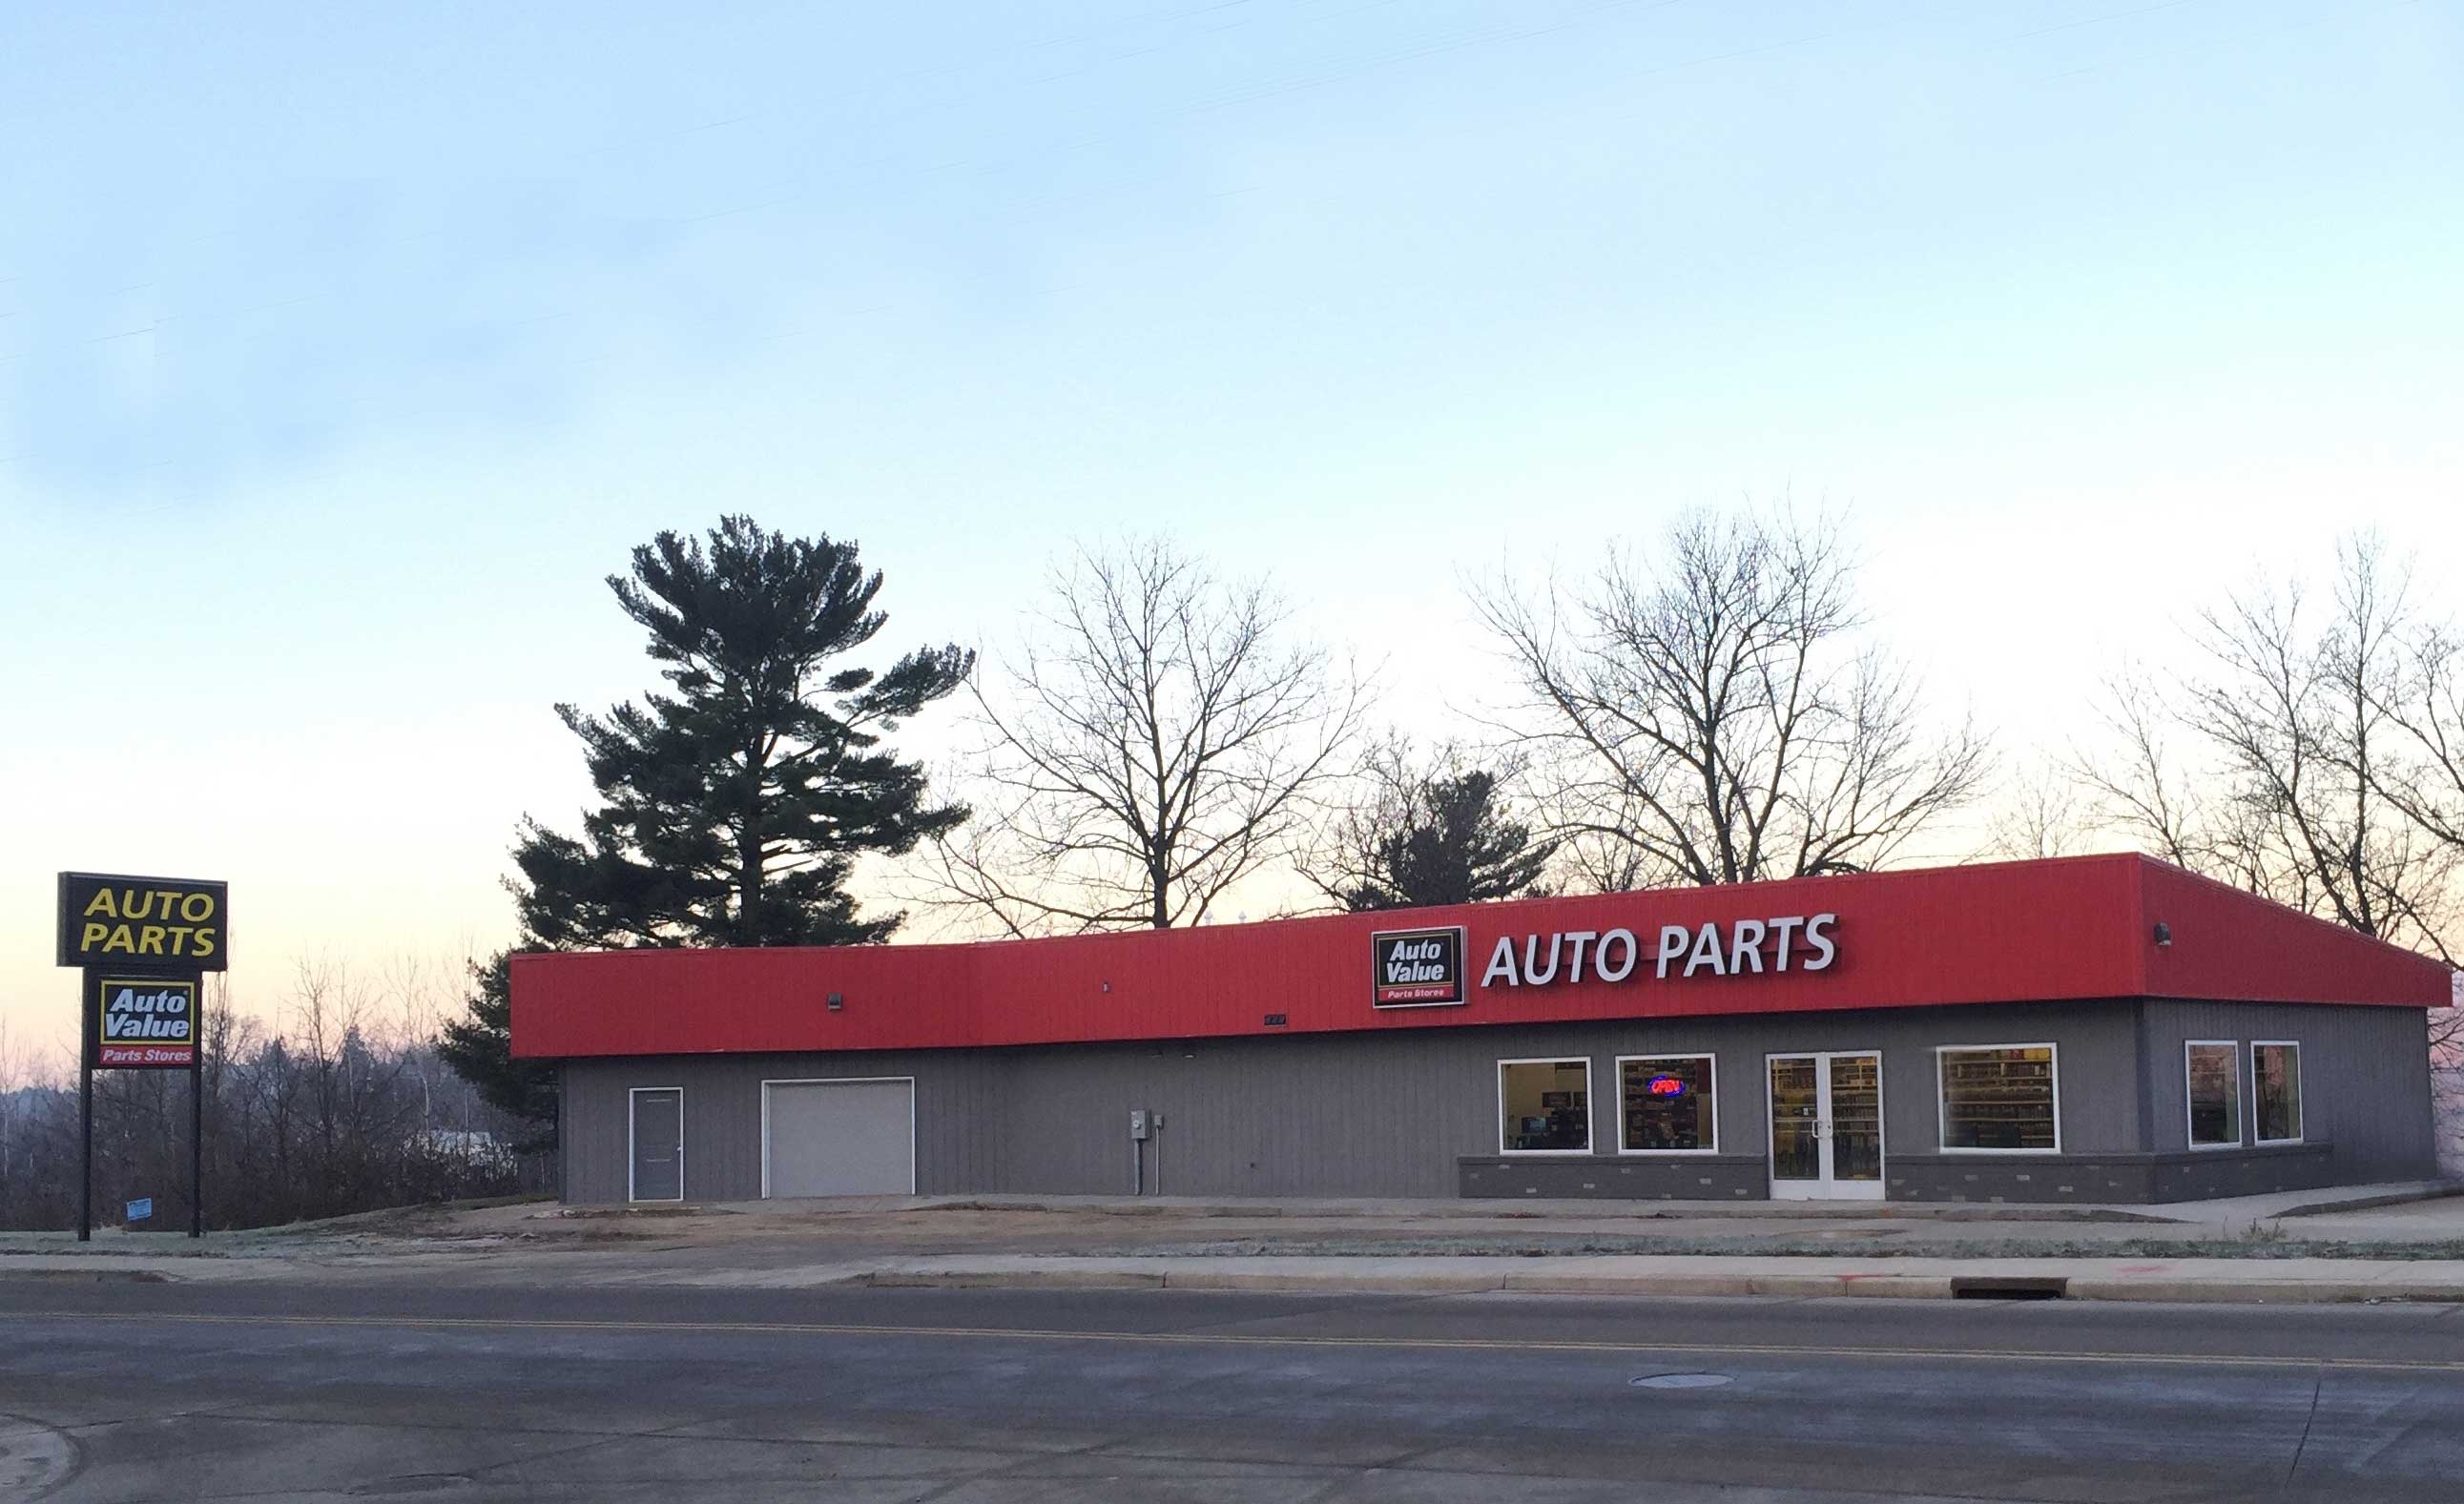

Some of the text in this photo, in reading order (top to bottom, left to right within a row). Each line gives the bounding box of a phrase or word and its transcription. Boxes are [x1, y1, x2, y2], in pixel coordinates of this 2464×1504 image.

[83, 888, 215, 922] AUTO
[80, 922, 216, 958] PARTS
[1389, 938, 1441, 961] Auto
[1480, 913, 1837, 988] AUTO PARTS
[1386, 960, 1445, 983] Value
[110, 988, 187, 1014] Auto
[1387, 988, 1444, 999] Parts Stores
[105, 1013, 190, 1038] Value
[102, 1049, 192, 1061] Parts Stores
[1651, 1079, 1680, 1094] OPEN
